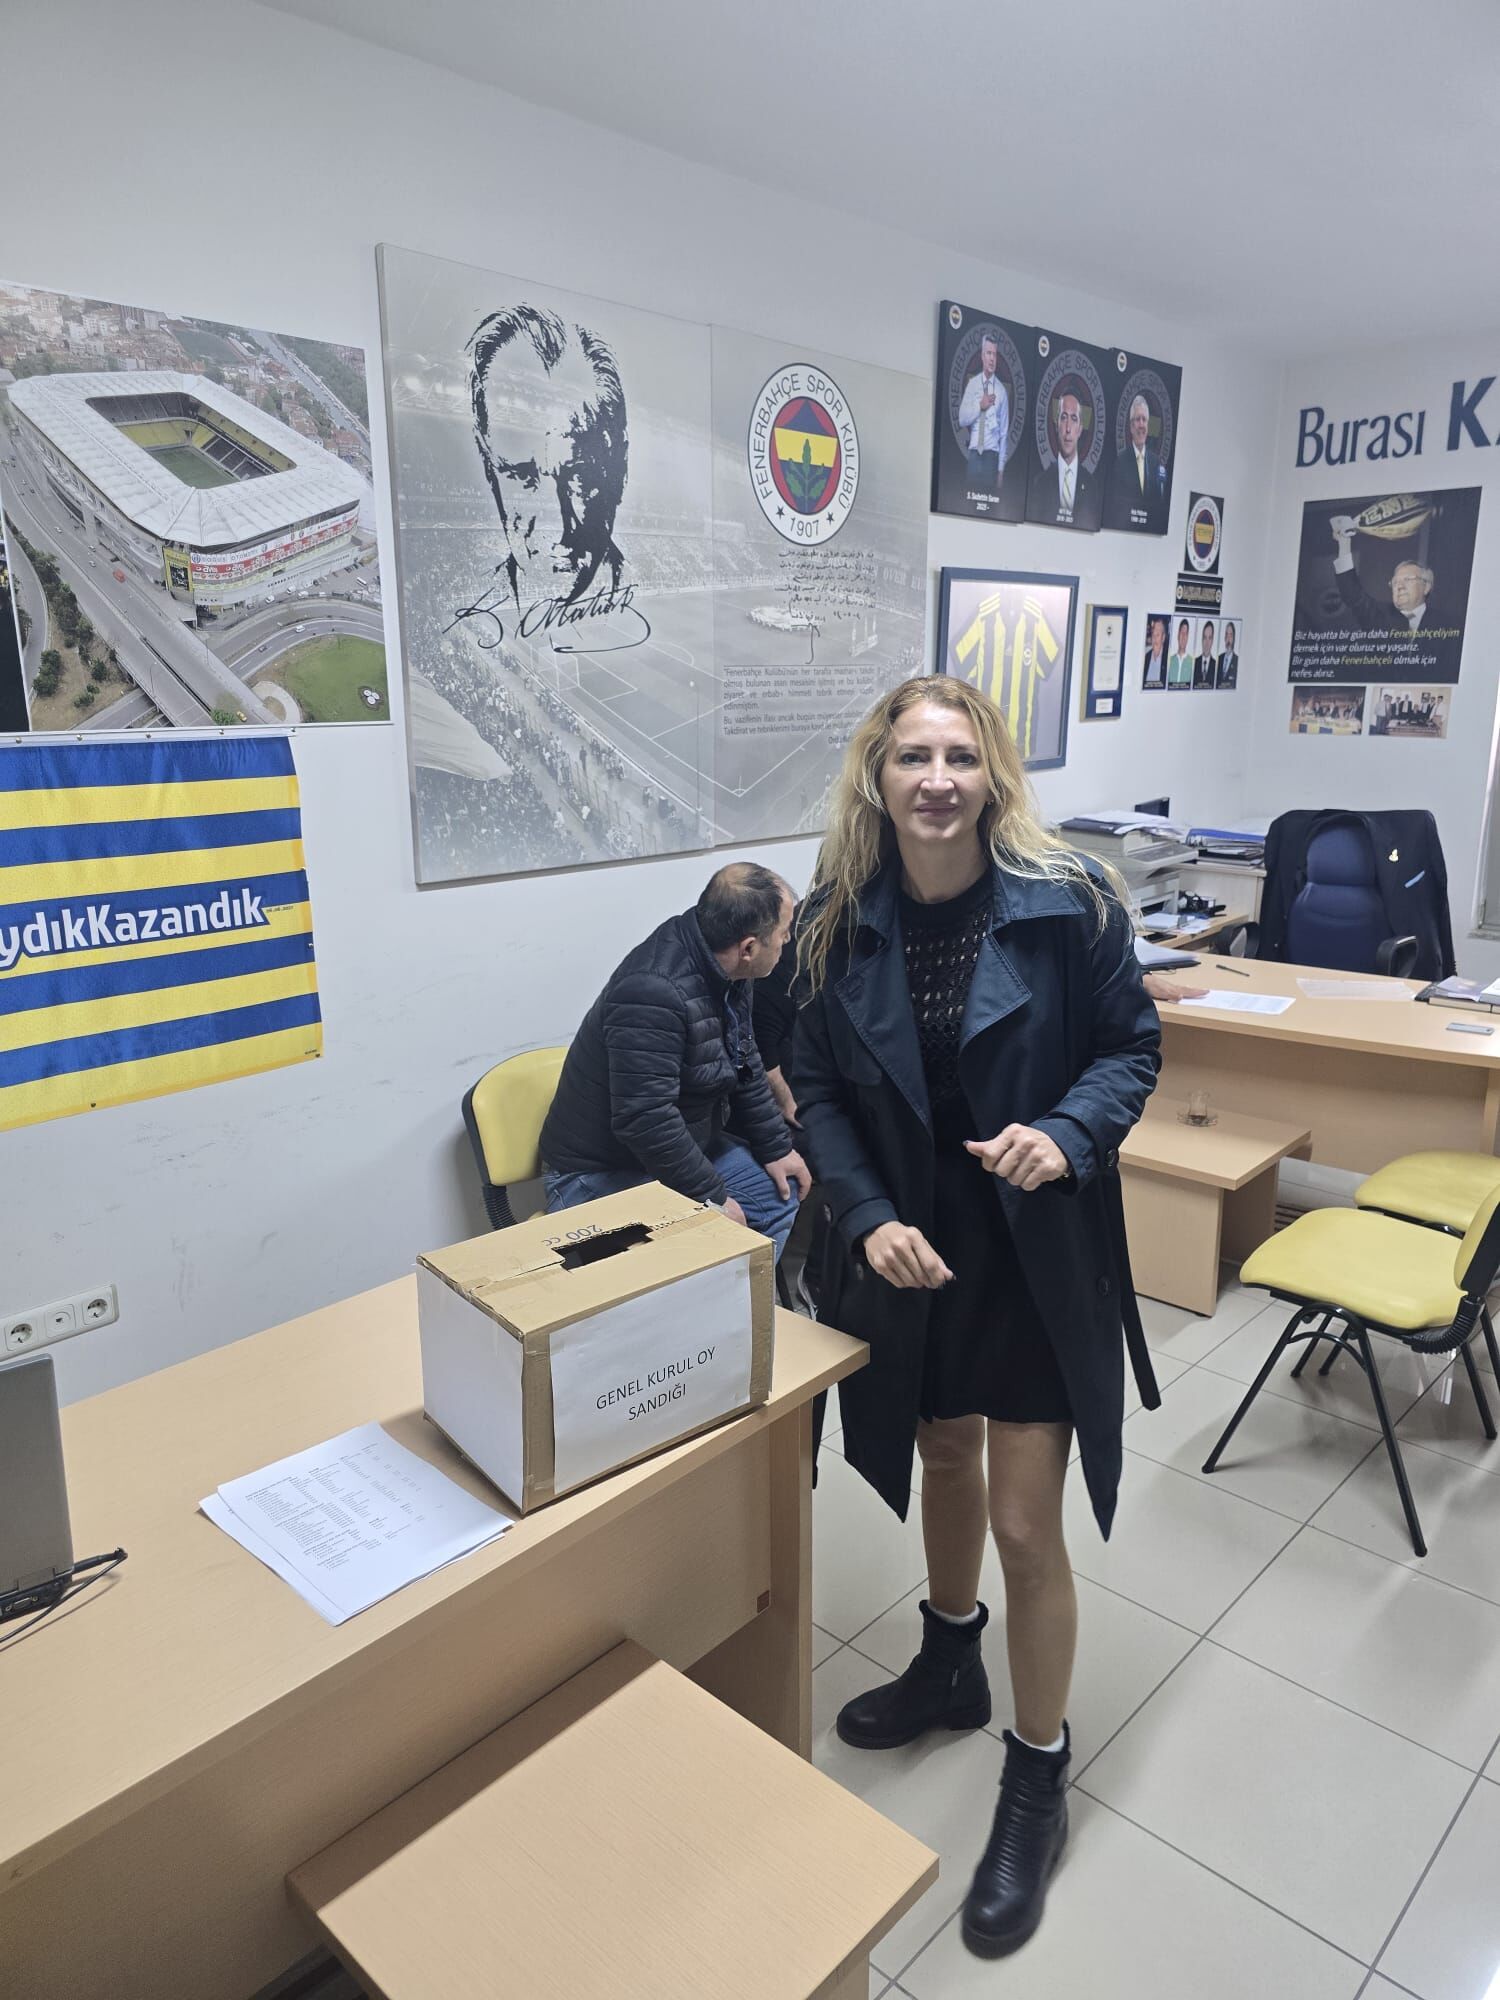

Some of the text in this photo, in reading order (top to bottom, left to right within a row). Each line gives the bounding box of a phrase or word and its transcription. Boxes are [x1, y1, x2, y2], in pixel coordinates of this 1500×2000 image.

[754, 373, 857, 510] FENERBAHÇE SPOR KULÜBÜ
[1295, 407, 1426, 468] Burası
[790, 517, 820, 538] 1907
[1308, 630, 1338, 641] hayatta
[1339, 629, 1349, 639] bir
[1350, 630, 1367, 641] gün
[1367, 629, 1388, 639] daha
[1292, 643, 1319, 653] demek
[1320, 655, 1340, 665] daha
[1341, 654, 1393, 667] Fenerbahçeli
[1393, 655, 1420, 664] olmak
[1420, 655, 1437, 667] için
[1290, 668, 1312, 678] nefes
[566, 1224, 602, 1241] 200
[596, 1347, 715, 1410] GENEL KURUL OY
[628, 1383, 686, 1420] SANDIĞI
